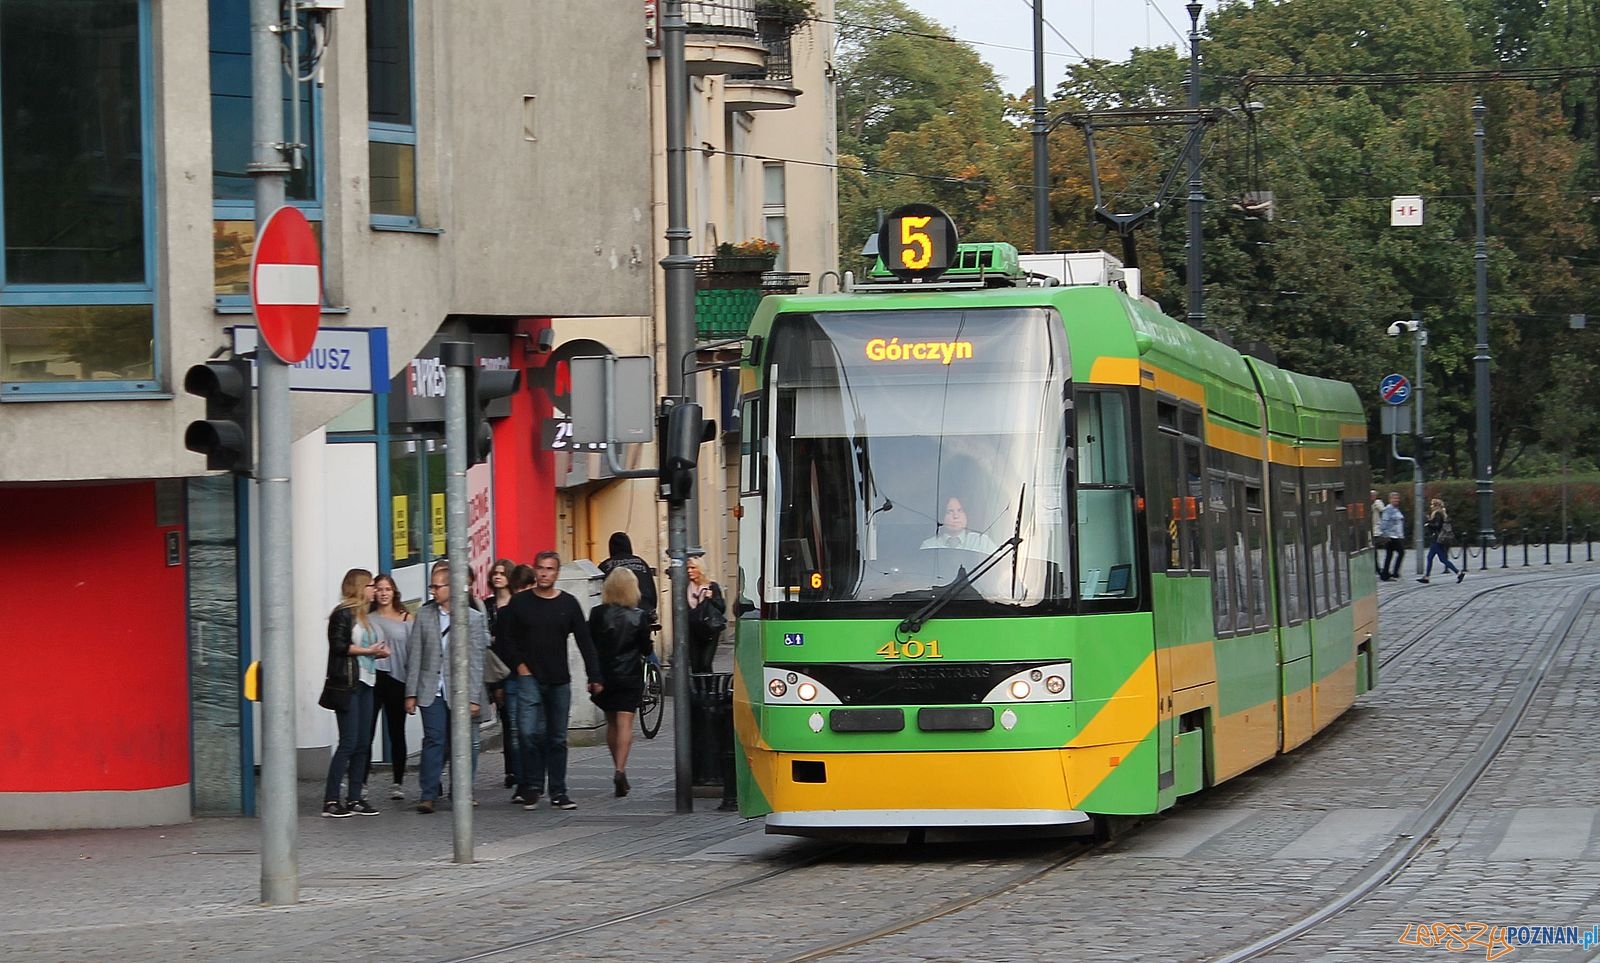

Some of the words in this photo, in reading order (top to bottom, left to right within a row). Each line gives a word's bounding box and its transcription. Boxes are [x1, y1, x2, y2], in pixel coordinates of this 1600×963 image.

[901, 216, 933, 270] 5
[865, 337, 973, 365] Górczyn
[810, 573, 823, 589] 6
[876, 639, 944, 660] 401
